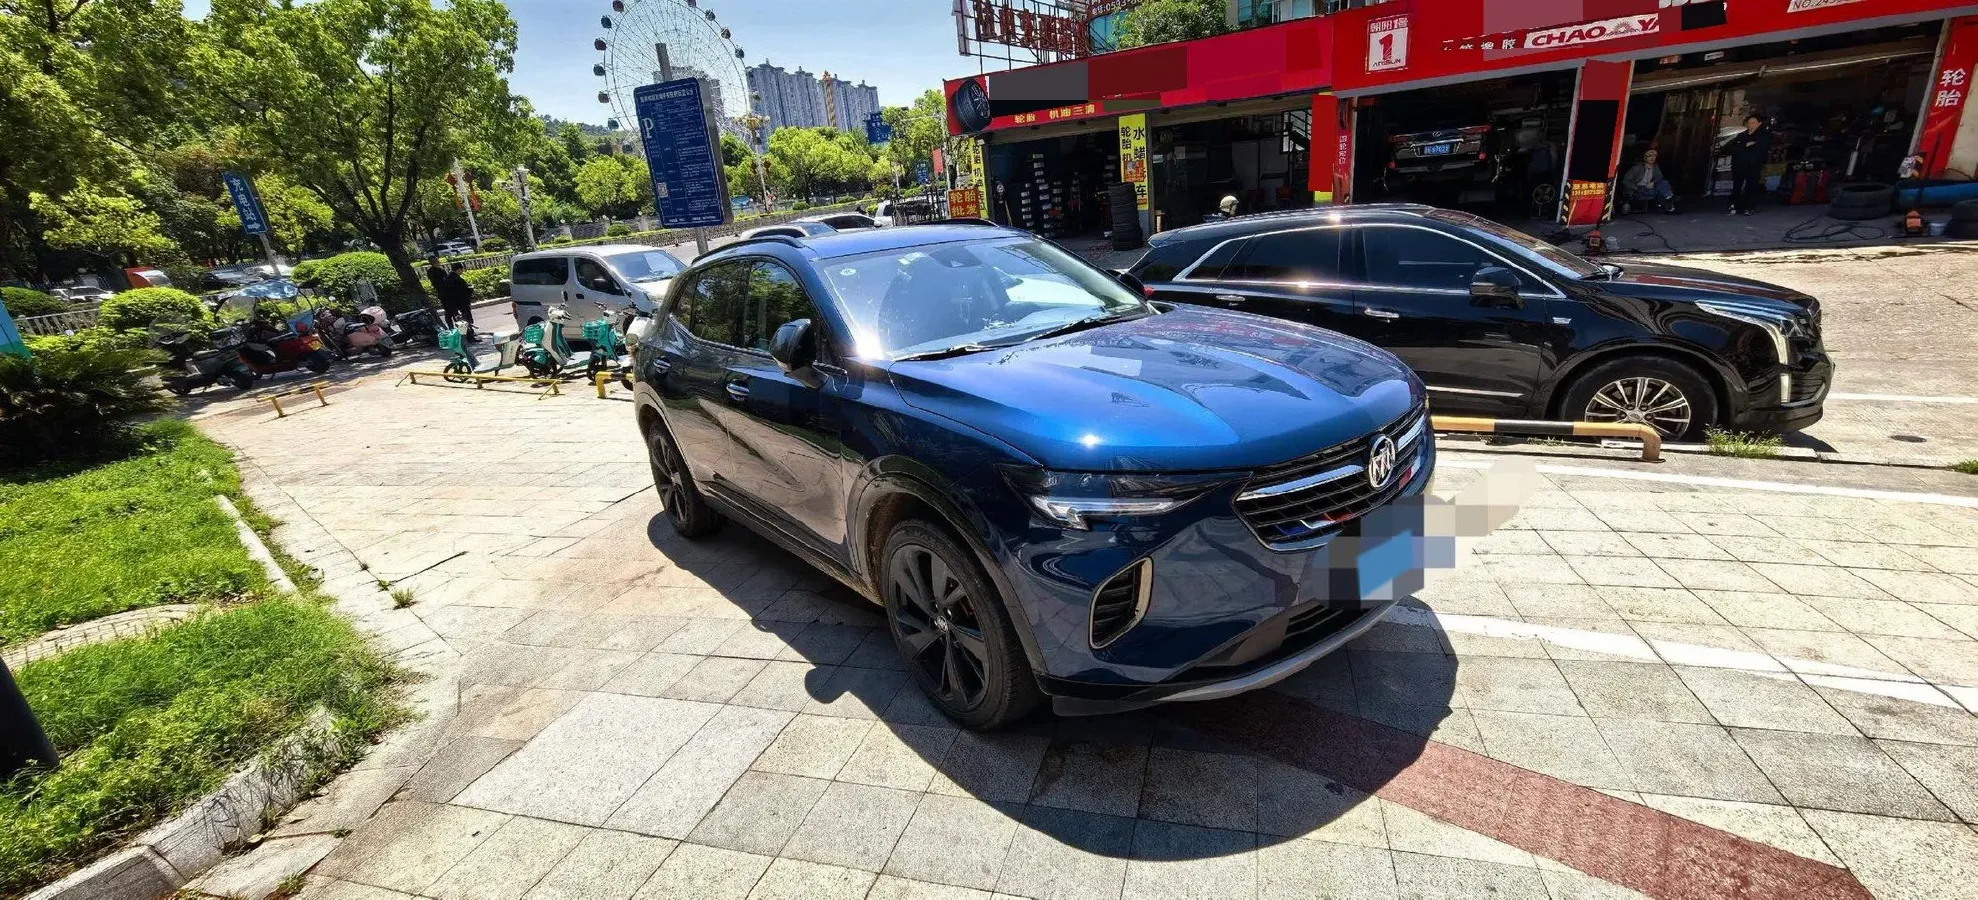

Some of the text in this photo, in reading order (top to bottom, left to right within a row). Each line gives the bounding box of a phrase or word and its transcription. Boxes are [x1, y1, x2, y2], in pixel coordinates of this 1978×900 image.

[1531, 26, 1607, 46] CHAO
[1935, 67, 1967, 107] 轮胎
[1014, 113, 1036, 124] 轮胎
[641, 117, 654, 139] P
[949, 190, 976, 203] 轮胎
[950, 203, 978, 217] 批发
